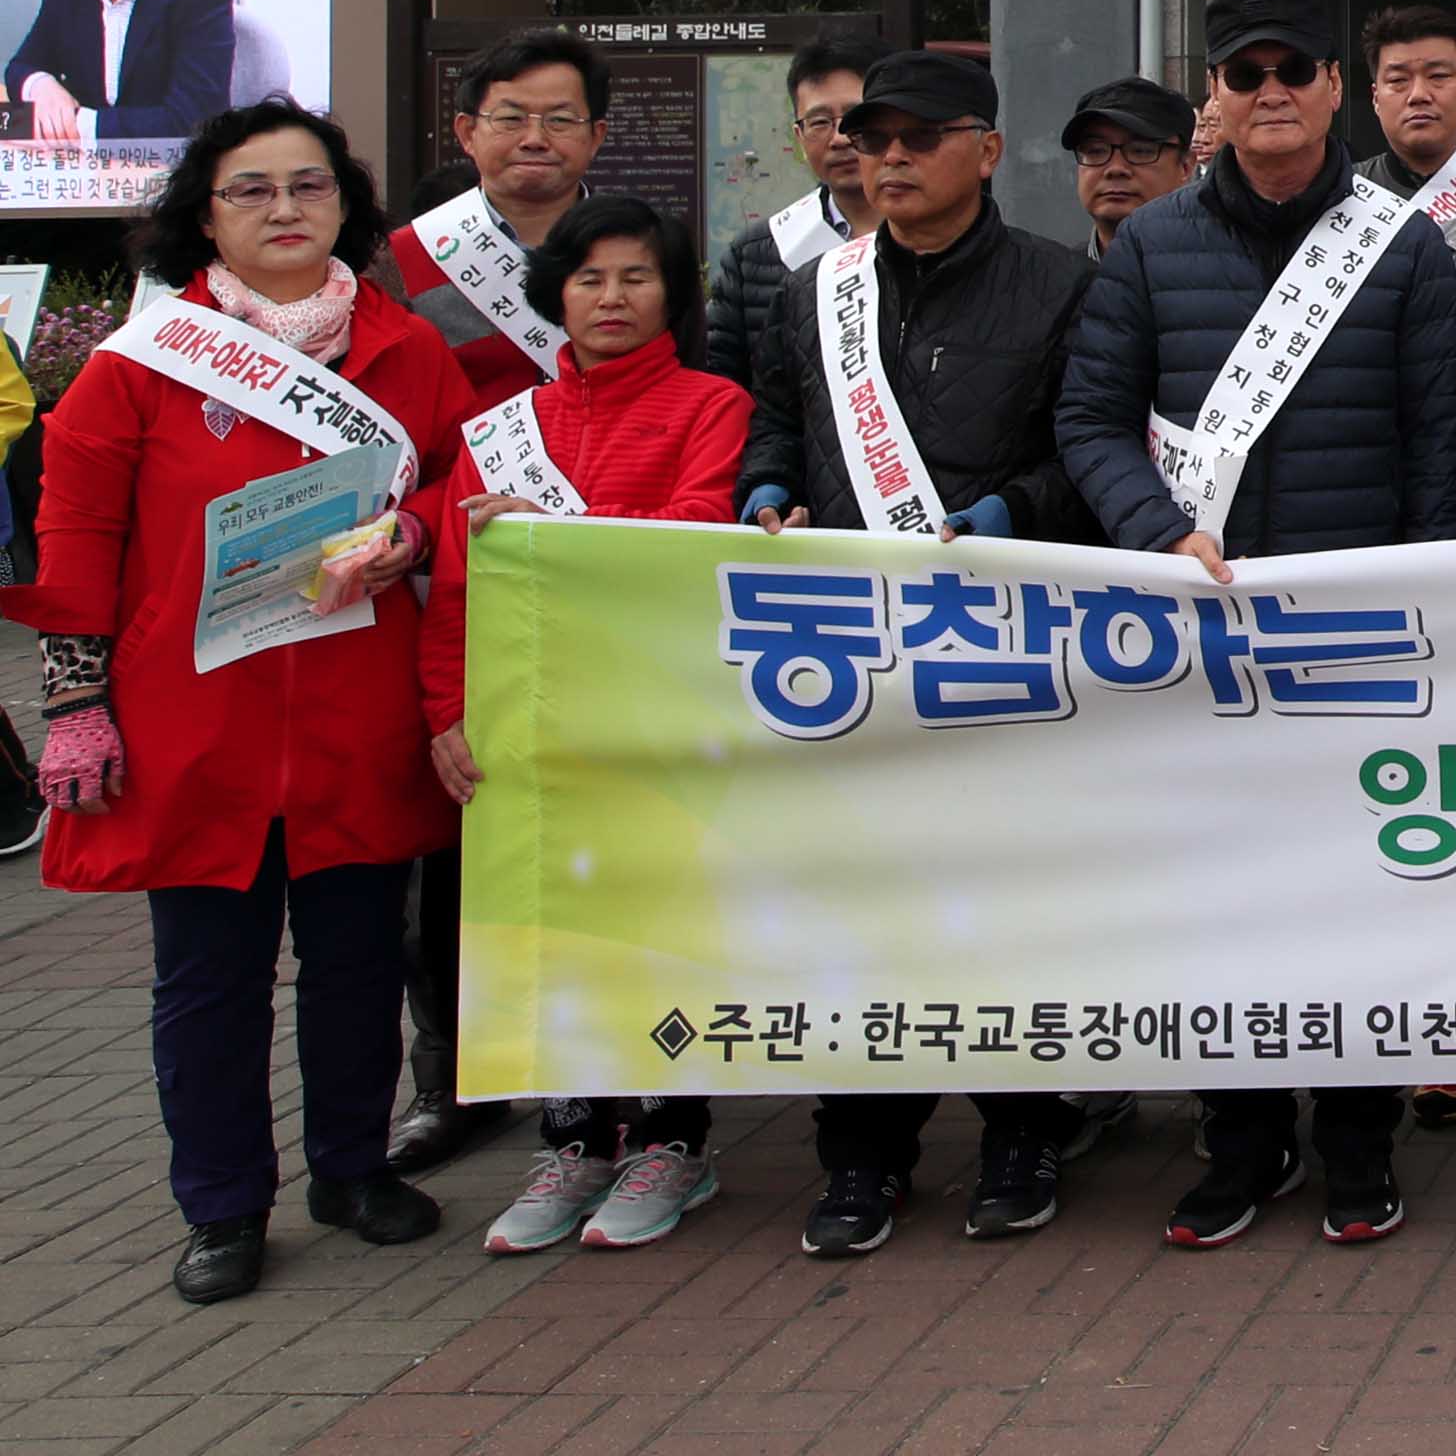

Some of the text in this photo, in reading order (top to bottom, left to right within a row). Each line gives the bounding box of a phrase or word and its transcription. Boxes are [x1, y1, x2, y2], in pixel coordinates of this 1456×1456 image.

[86, 147, 114, 171] 정말
[152, 315, 290, 392] 음주운전
[722, 568, 1428, 736] 동참하는
[701, 1000, 811, 1063] 주관
[861, 997, 1346, 1062] 한국교통장애인협회
